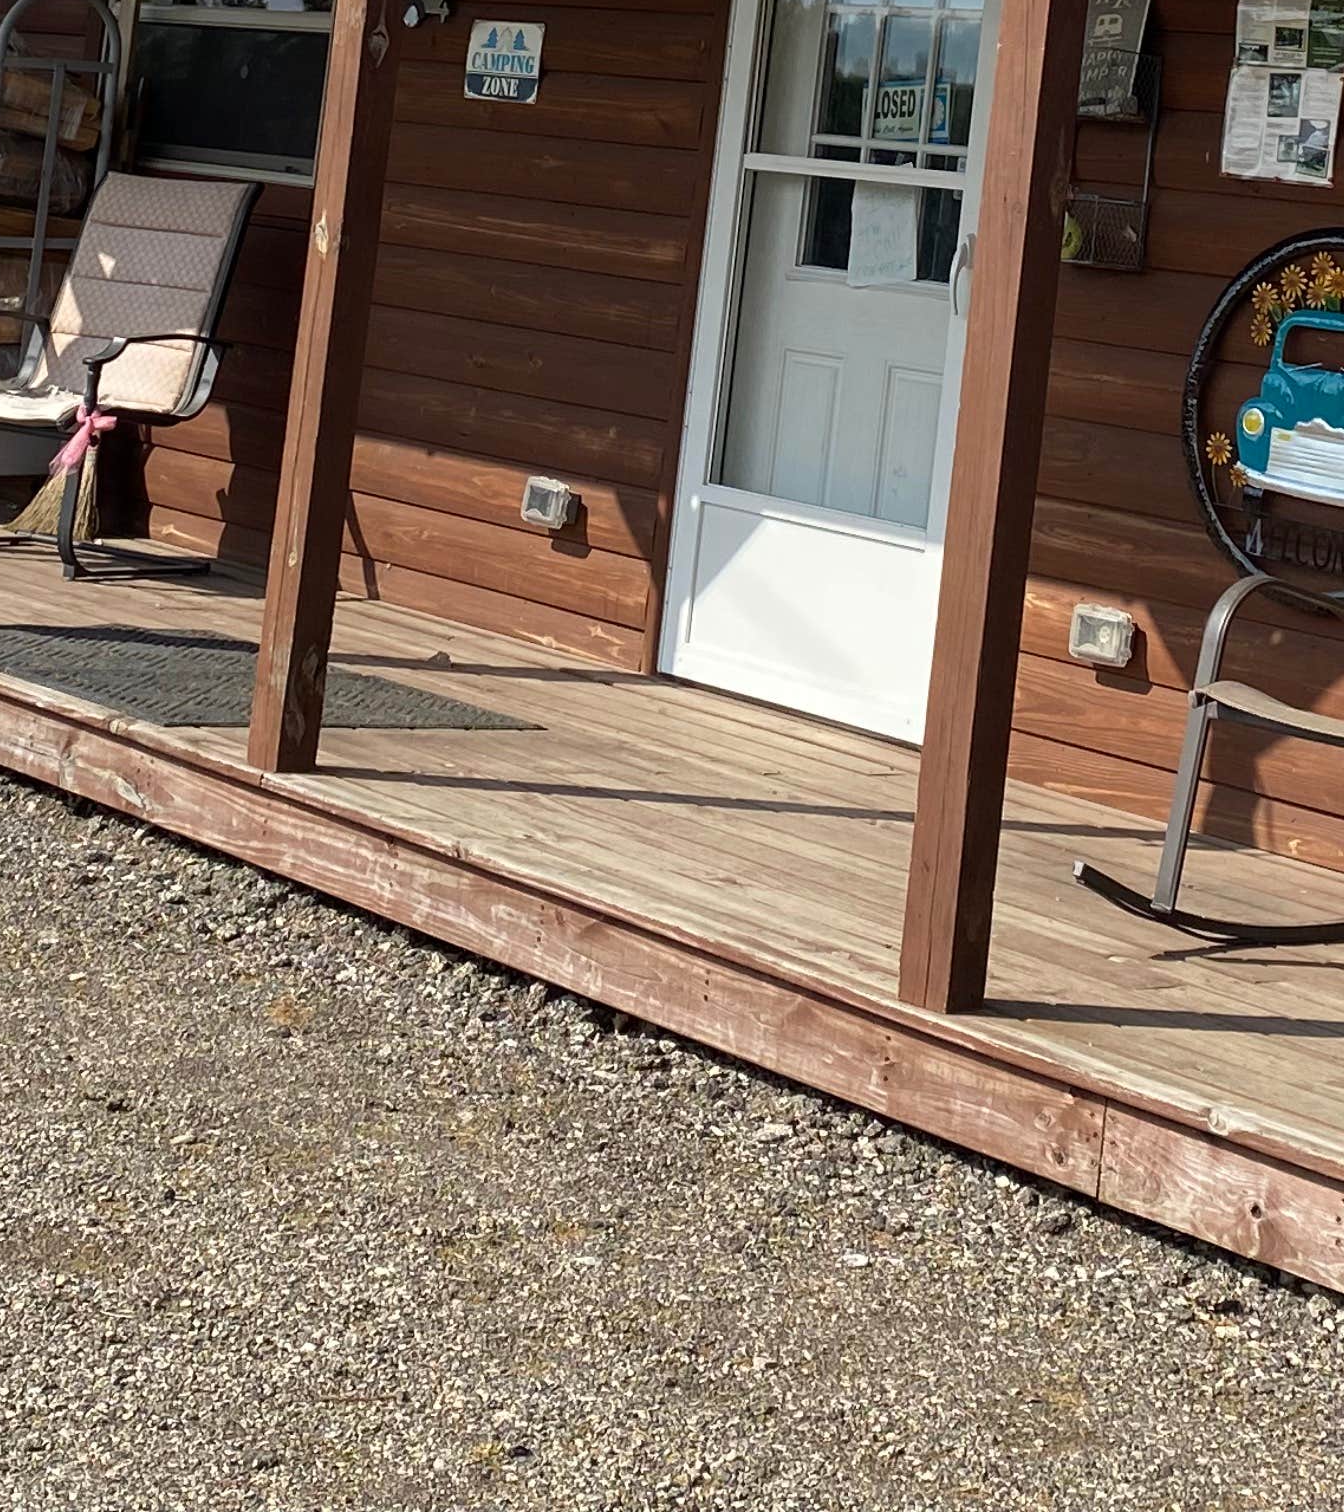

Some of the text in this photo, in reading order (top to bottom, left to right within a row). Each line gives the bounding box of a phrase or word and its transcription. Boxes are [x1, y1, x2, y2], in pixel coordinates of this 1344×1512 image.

[471, 51, 536, 75] CAMPING
[481, 75, 520, 98] ZONE
[865, 88, 916, 120] LOSED
